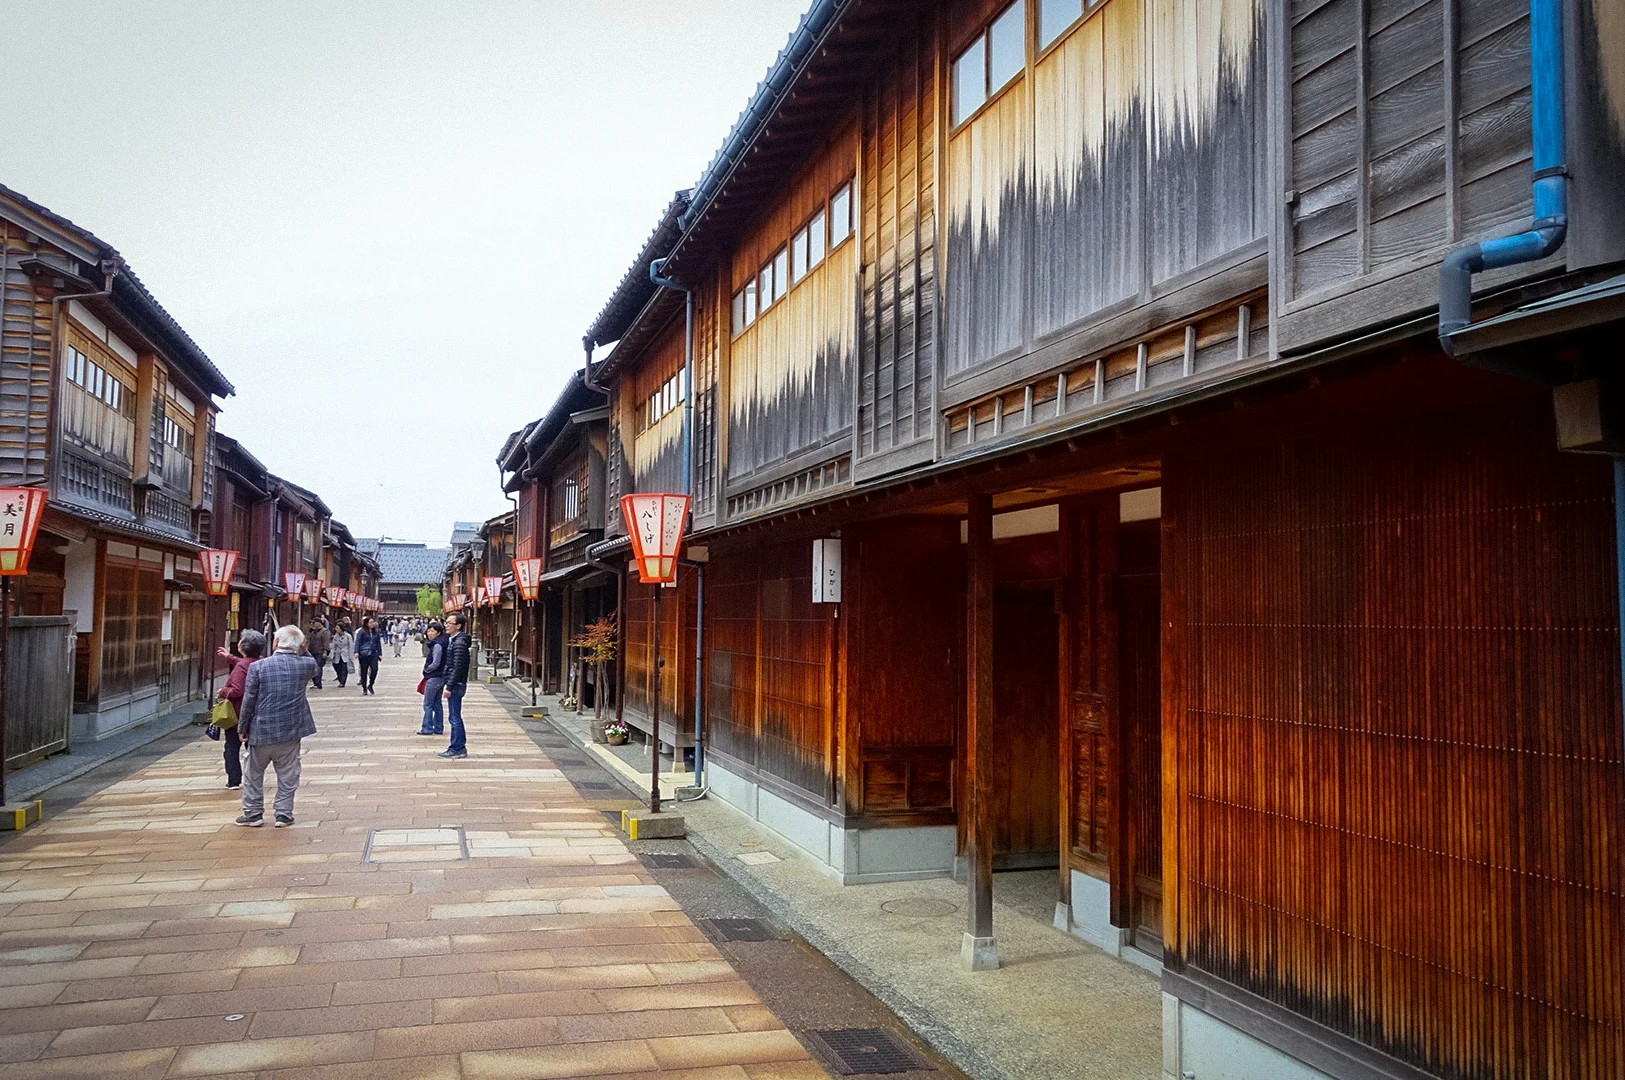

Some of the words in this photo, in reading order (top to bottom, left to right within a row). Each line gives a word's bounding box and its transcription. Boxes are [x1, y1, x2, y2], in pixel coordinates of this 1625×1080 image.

[2, 503, 17, 536] 美月
[642, 510, 654, 544] 八しげ
[828, 568, 836, 597] ひがし
